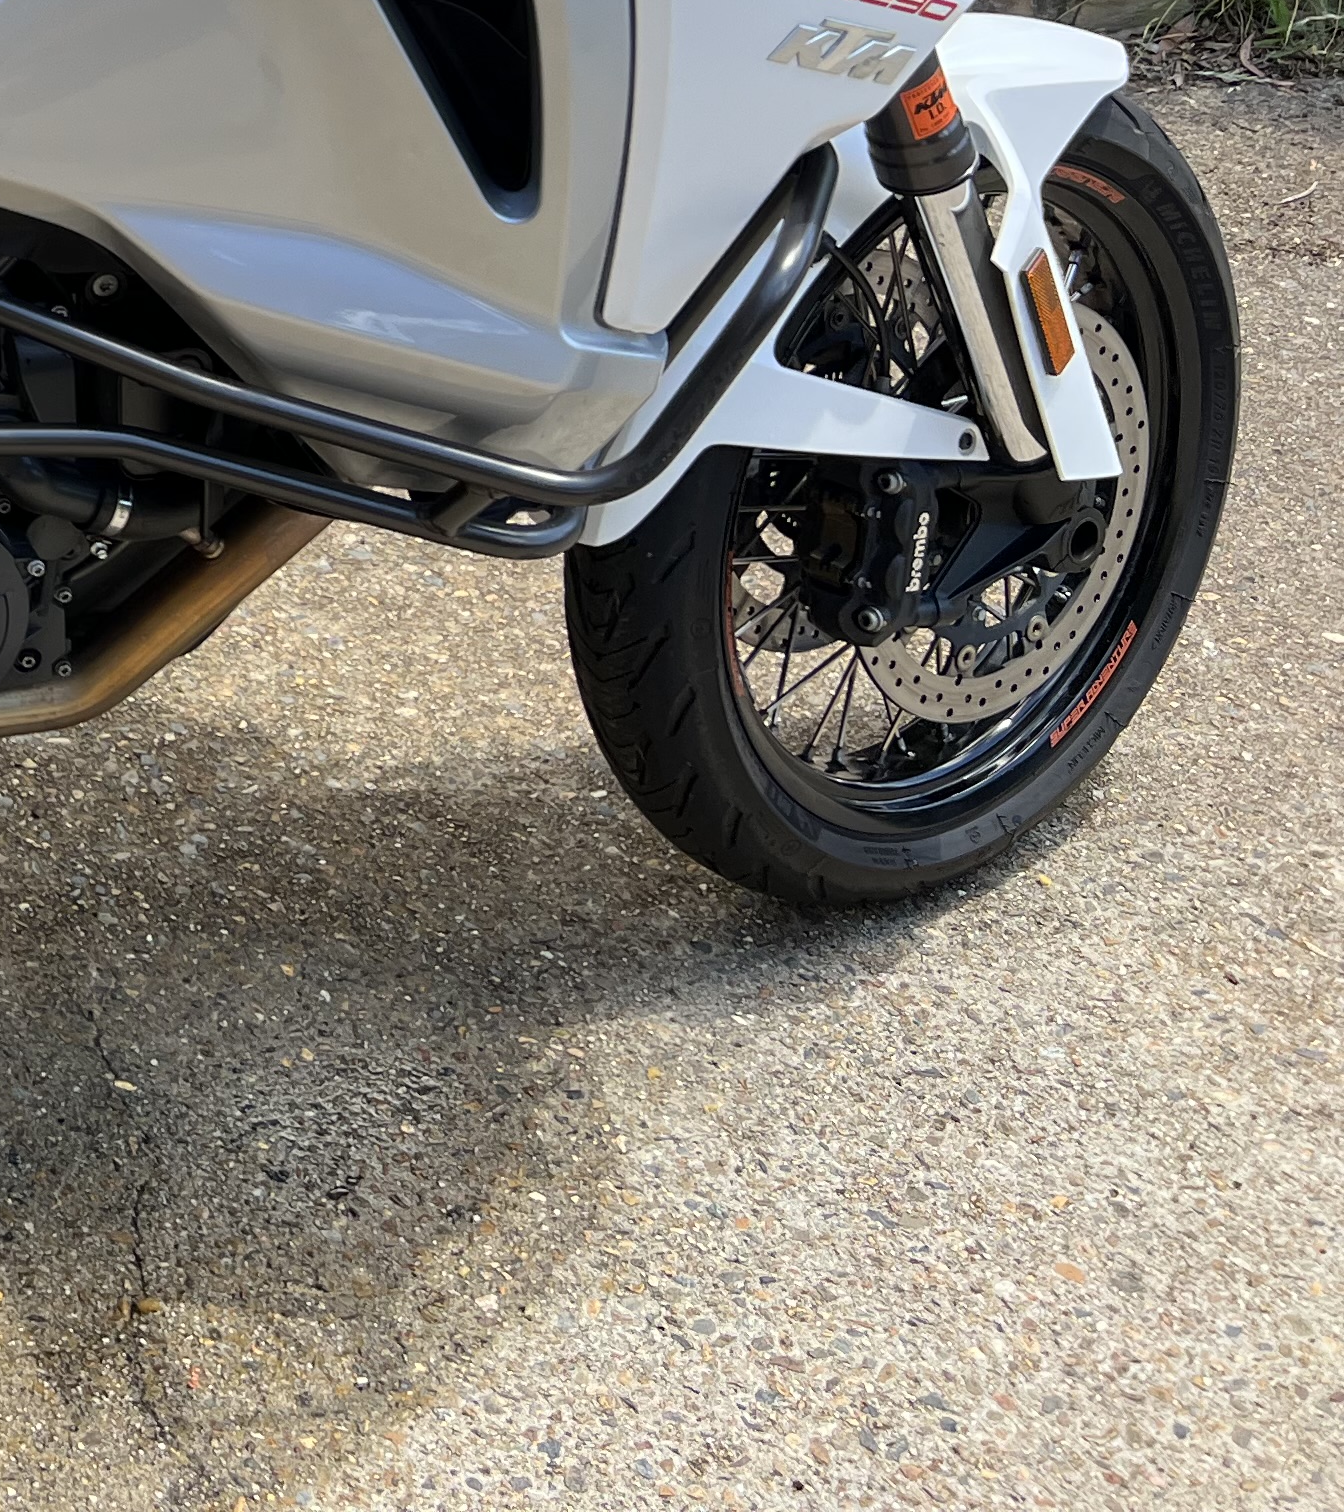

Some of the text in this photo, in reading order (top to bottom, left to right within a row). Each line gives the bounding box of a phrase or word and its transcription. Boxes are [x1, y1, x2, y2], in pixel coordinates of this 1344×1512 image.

[767, 17, 917, 85] KTM
[1156, 201, 1217, 333] MICHELIN
[906, 511, 930, 592] brembo
[1049, 620, 1138, 748] SUPER ADVENTURE
